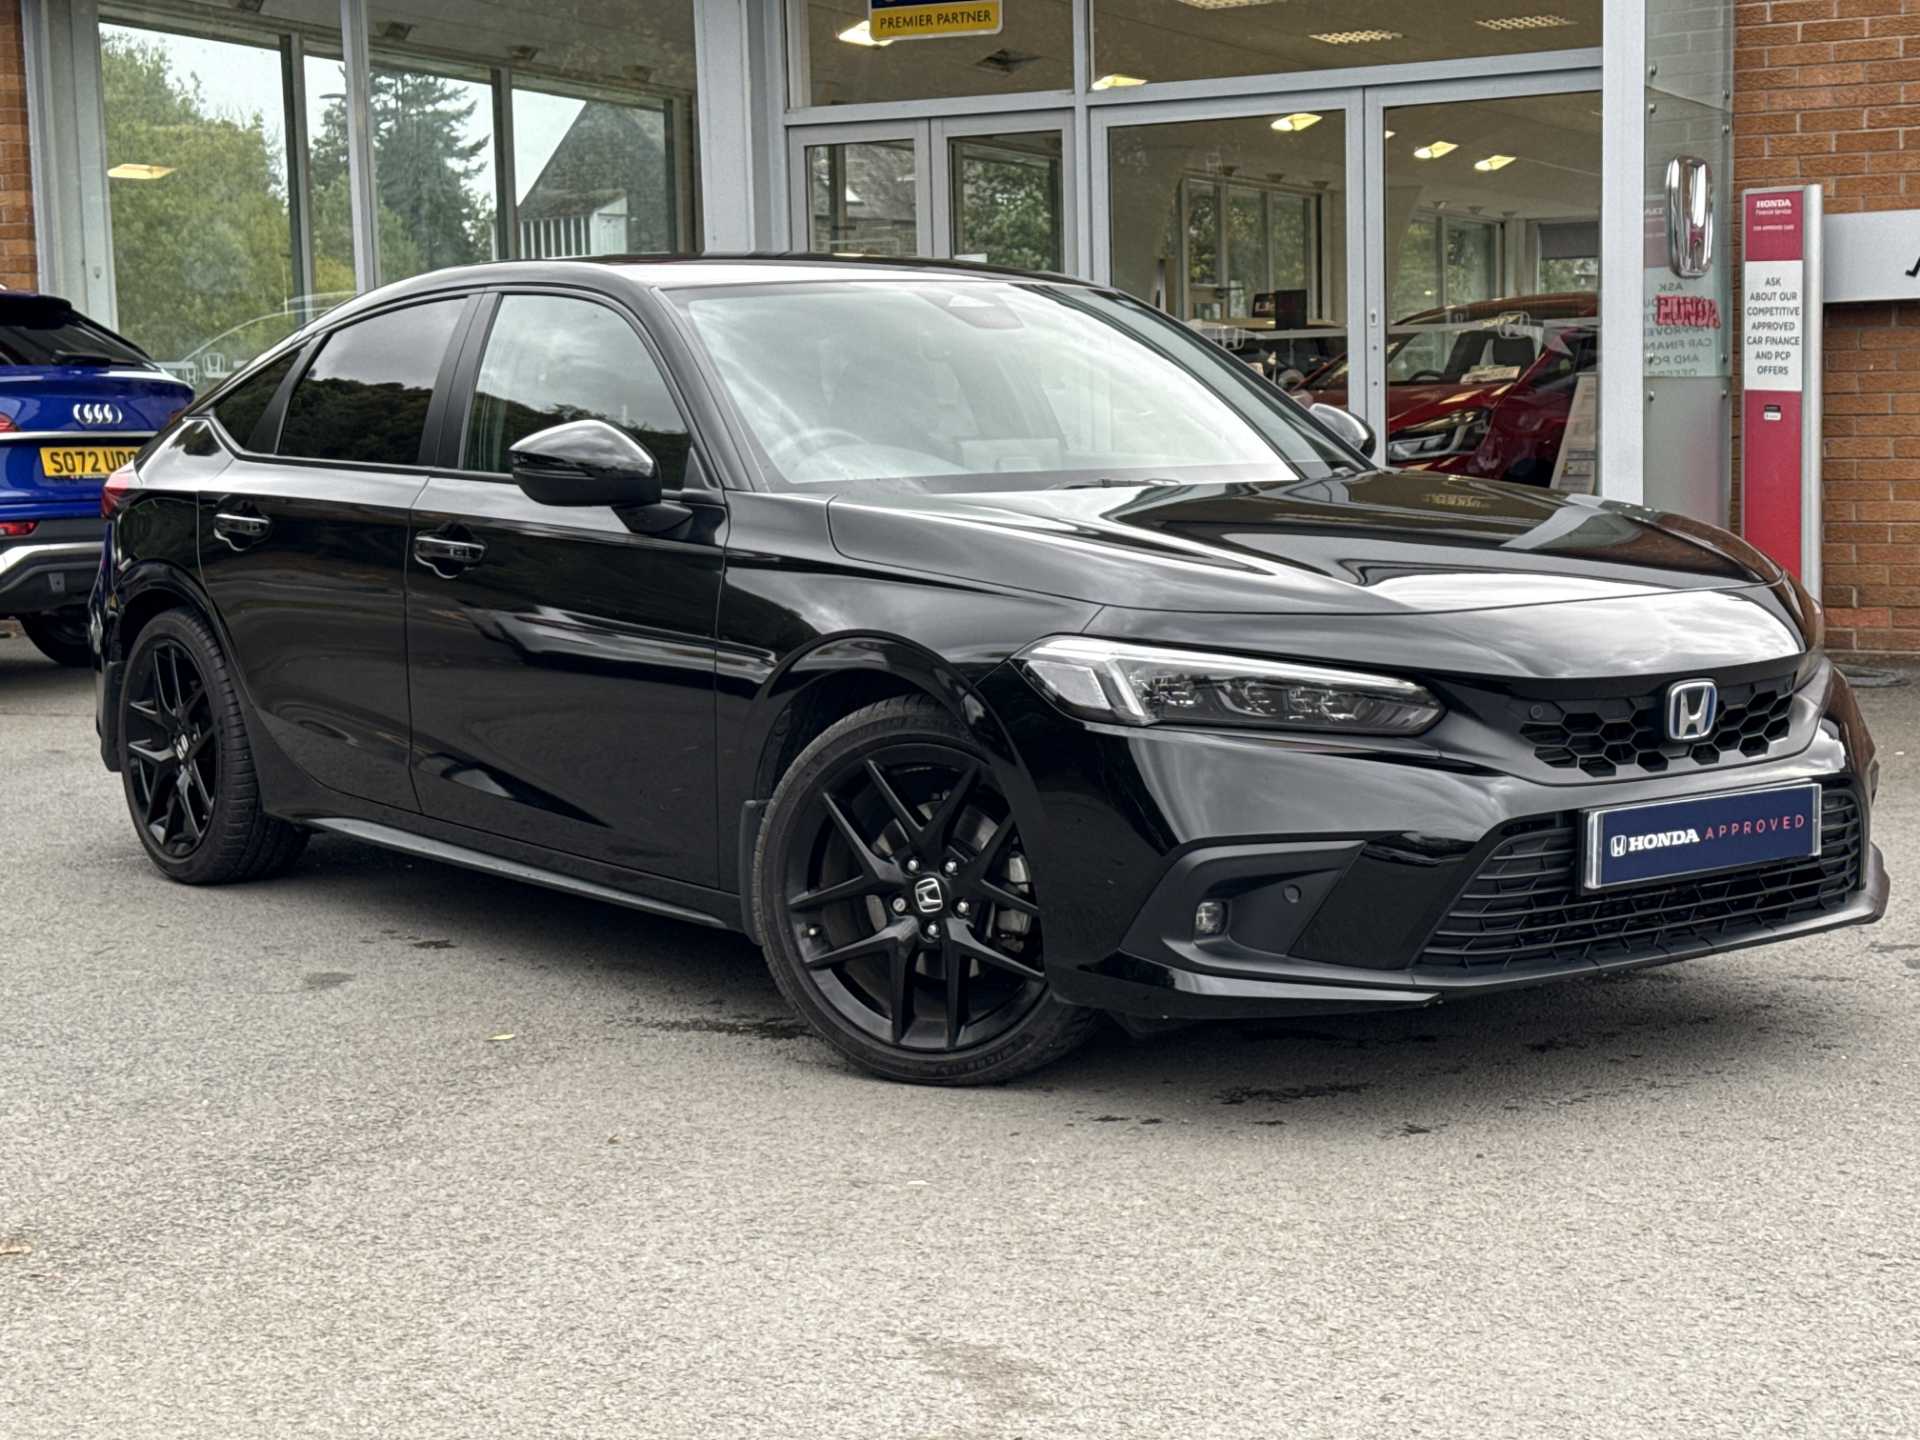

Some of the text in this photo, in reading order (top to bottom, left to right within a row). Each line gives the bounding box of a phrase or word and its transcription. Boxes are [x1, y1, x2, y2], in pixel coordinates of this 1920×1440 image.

[880, 10, 991, 29] PREMIER PARTNER
[1756, 199, 1792, 208] HONDA
[1765, 277, 1782, 287] ASK
[1750, 292, 1798, 301] ABOUT OUR
[1746, 306, 1800, 316] COMPETITIVE
[1751, 321, 1796, 331] APPROVED
[1746, 336, 1800, 346] CAR FINANCE
[1754, 351, 1791, 361] AND PCP
[1756, 366, 1789, 376] OFFERS
[1628, 829, 1700, 852] HONDA
[1705, 814, 1805, 841] APPROVED
